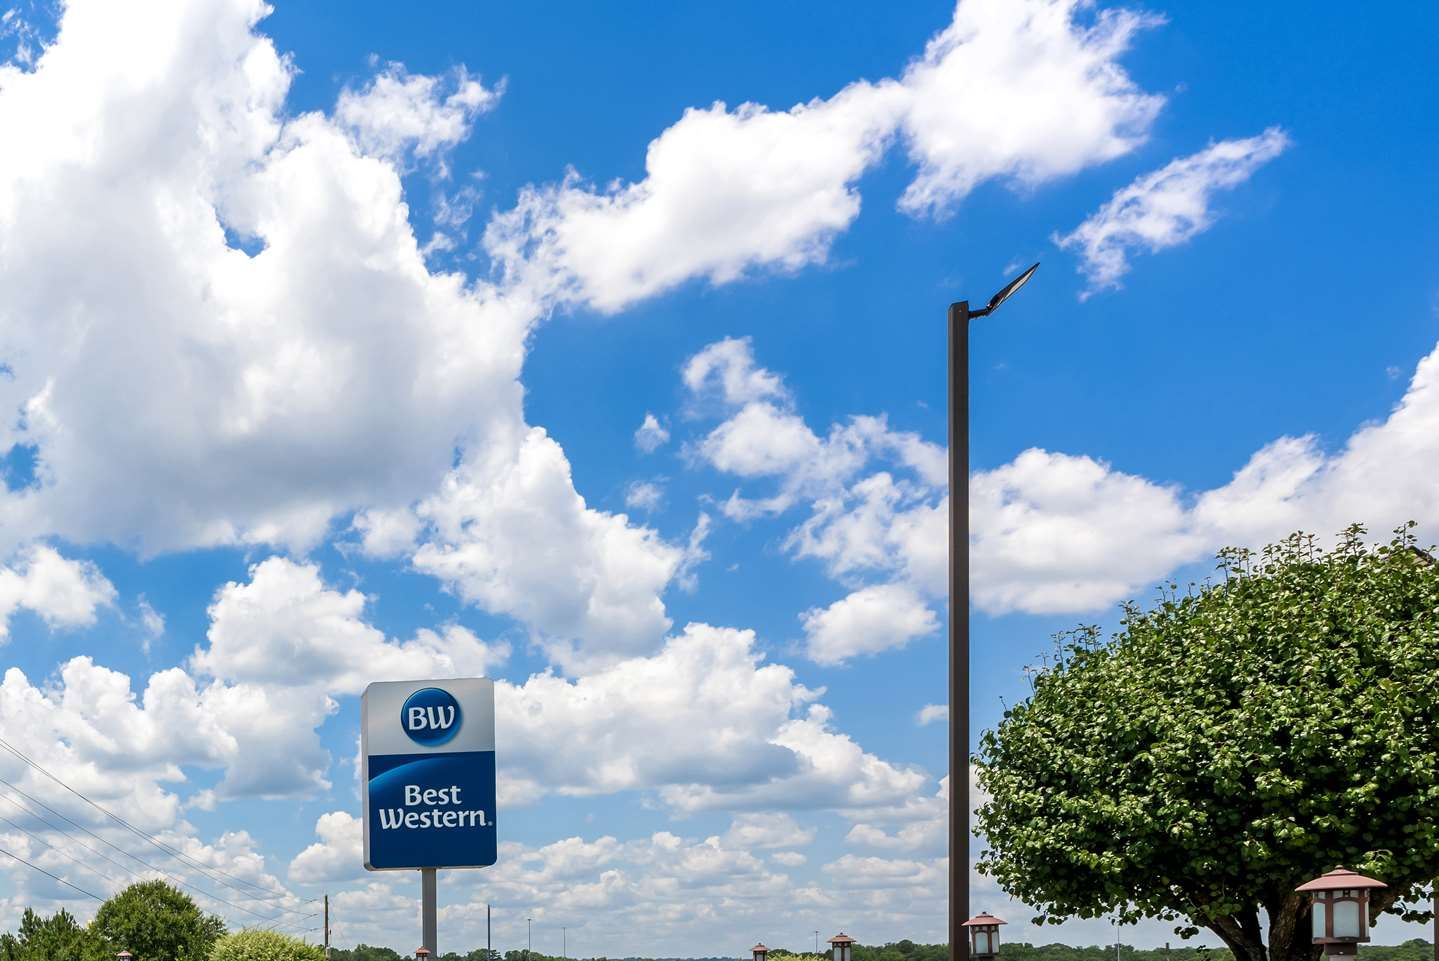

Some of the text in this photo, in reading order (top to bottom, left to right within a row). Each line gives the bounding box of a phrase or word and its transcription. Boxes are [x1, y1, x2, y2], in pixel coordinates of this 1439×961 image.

[408, 705, 455, 731] BW
[404, 784, 462, 807] Best
[378, 808, 488, 830] Western
